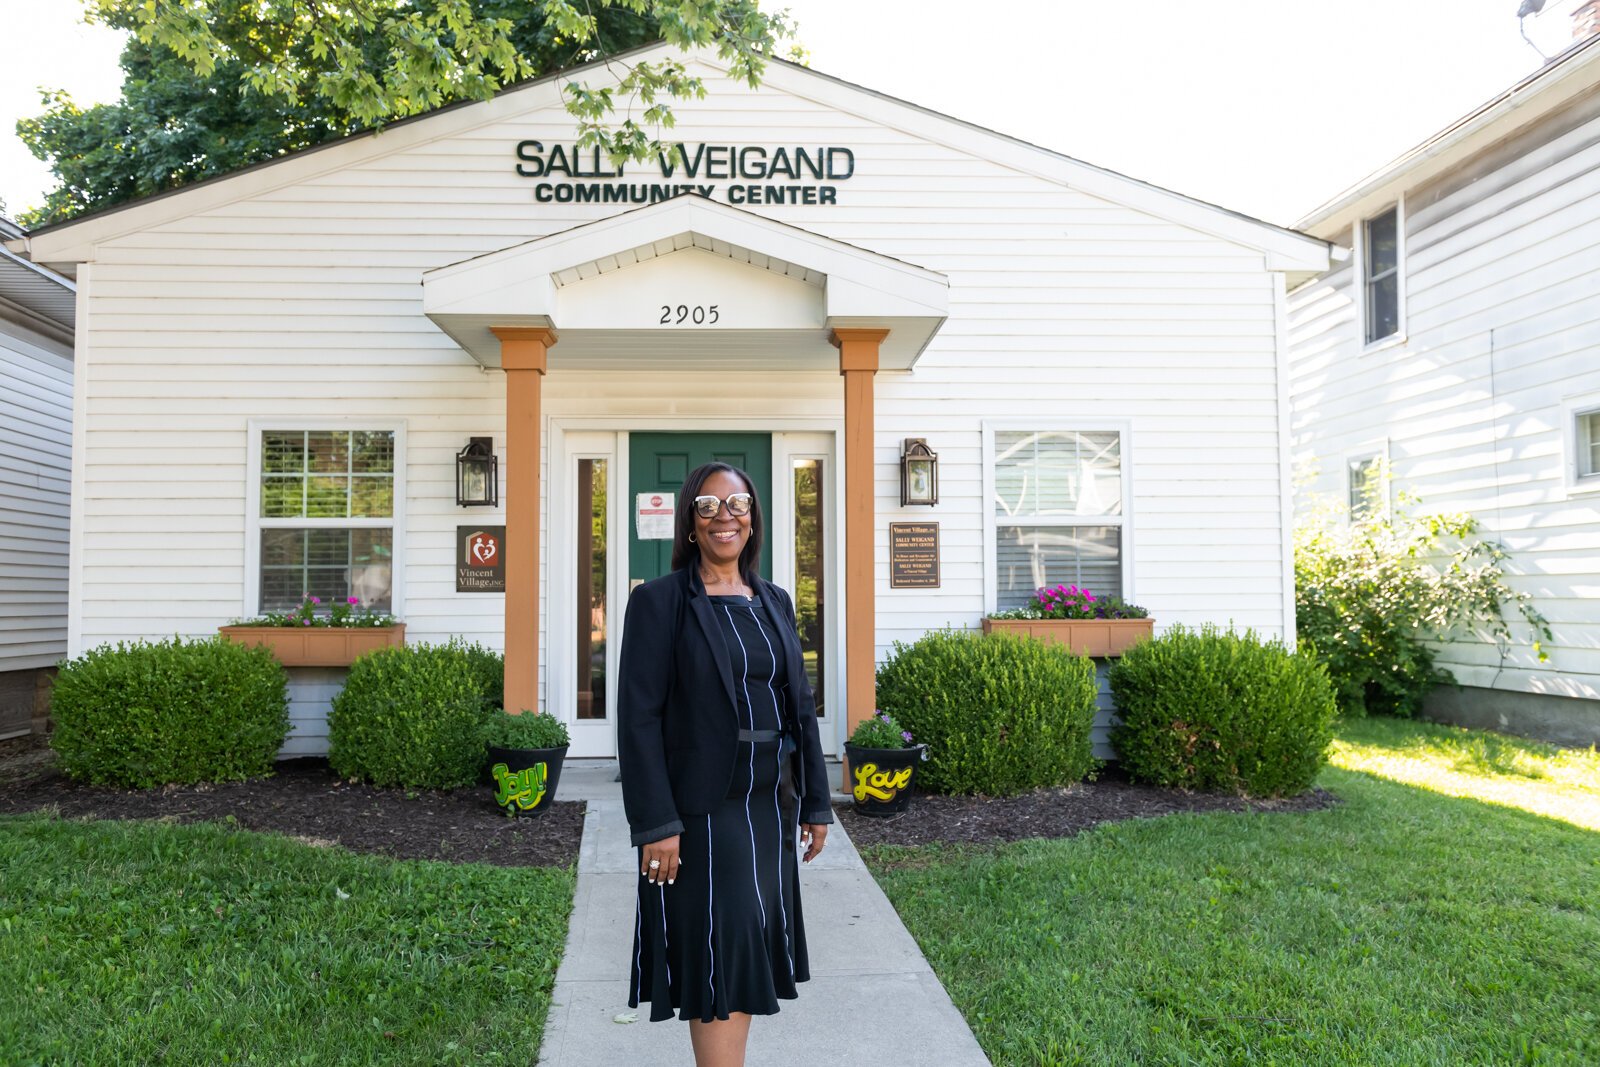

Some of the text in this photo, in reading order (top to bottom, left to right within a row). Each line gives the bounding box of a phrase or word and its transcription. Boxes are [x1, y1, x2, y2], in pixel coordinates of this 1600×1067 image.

[657, 142, 855, 180] WEIGAND
[728, 184, 837, 205] CENTER
[660, 304, 719, 325] 2905
[459, 568, 493, 577] Vincent
[854, 762, 912, 801] Love
